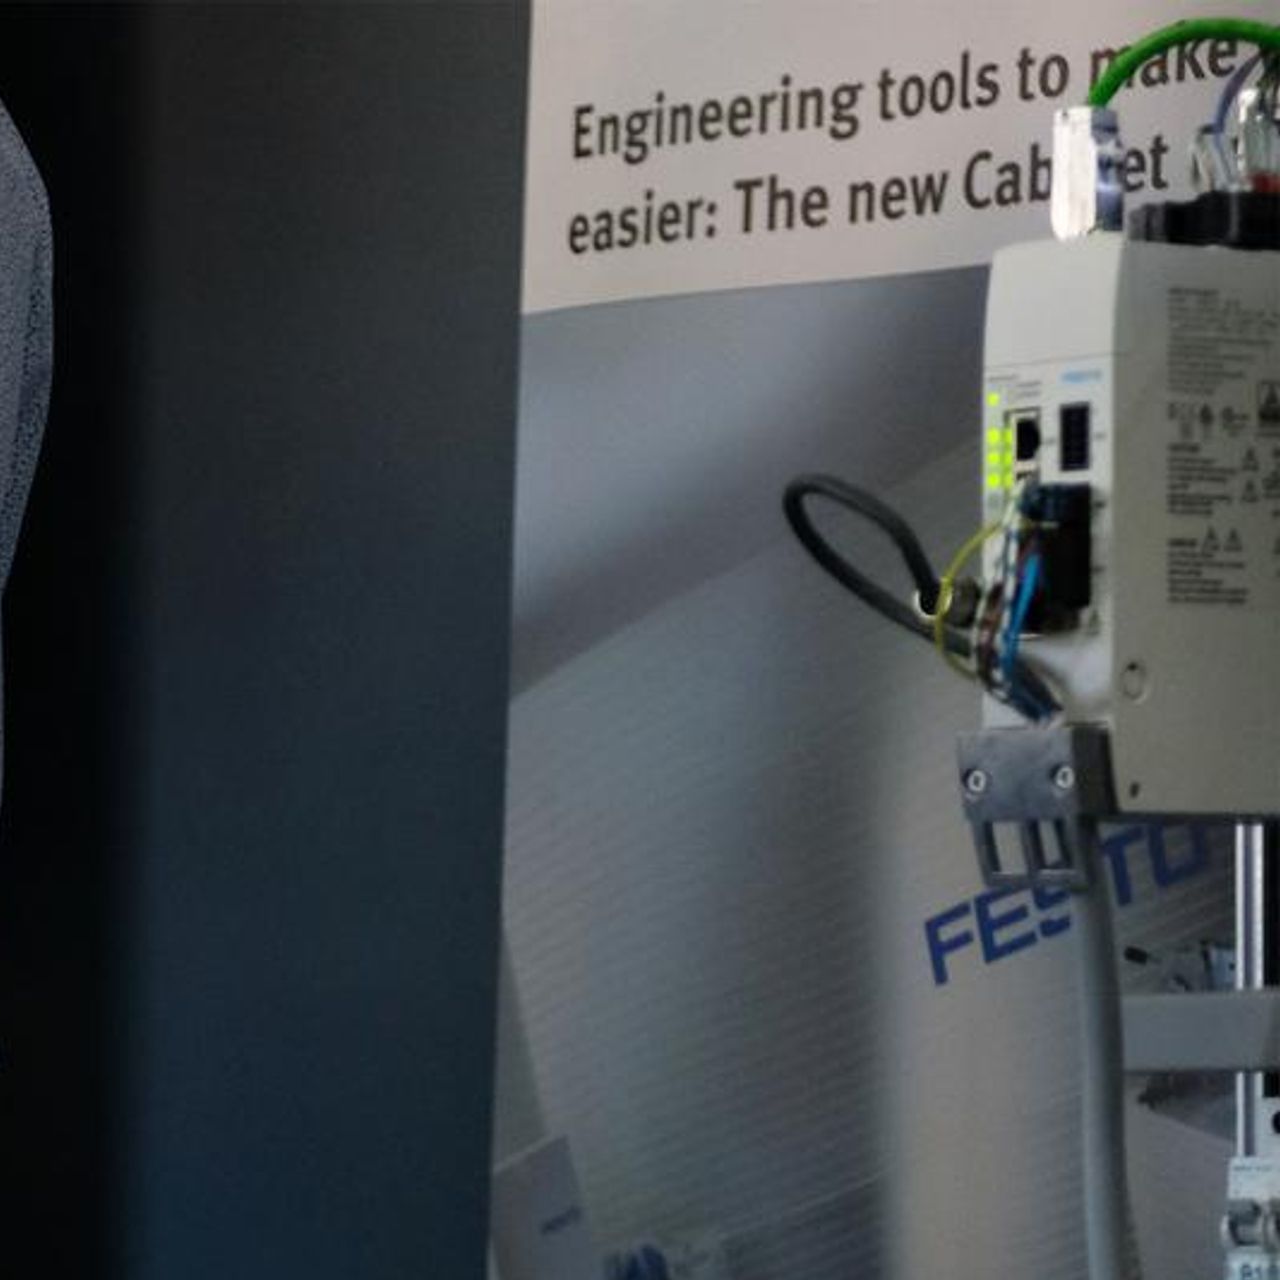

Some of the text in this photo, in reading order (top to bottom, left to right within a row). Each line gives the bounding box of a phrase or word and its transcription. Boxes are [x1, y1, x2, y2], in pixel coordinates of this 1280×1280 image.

[573, 73, 864, 165] Engineering
[877, 48, 1001, 121] tools
[1015, 46, 1071, 101] to
[569, 134, 1170, 254] easier: The new Cabet
